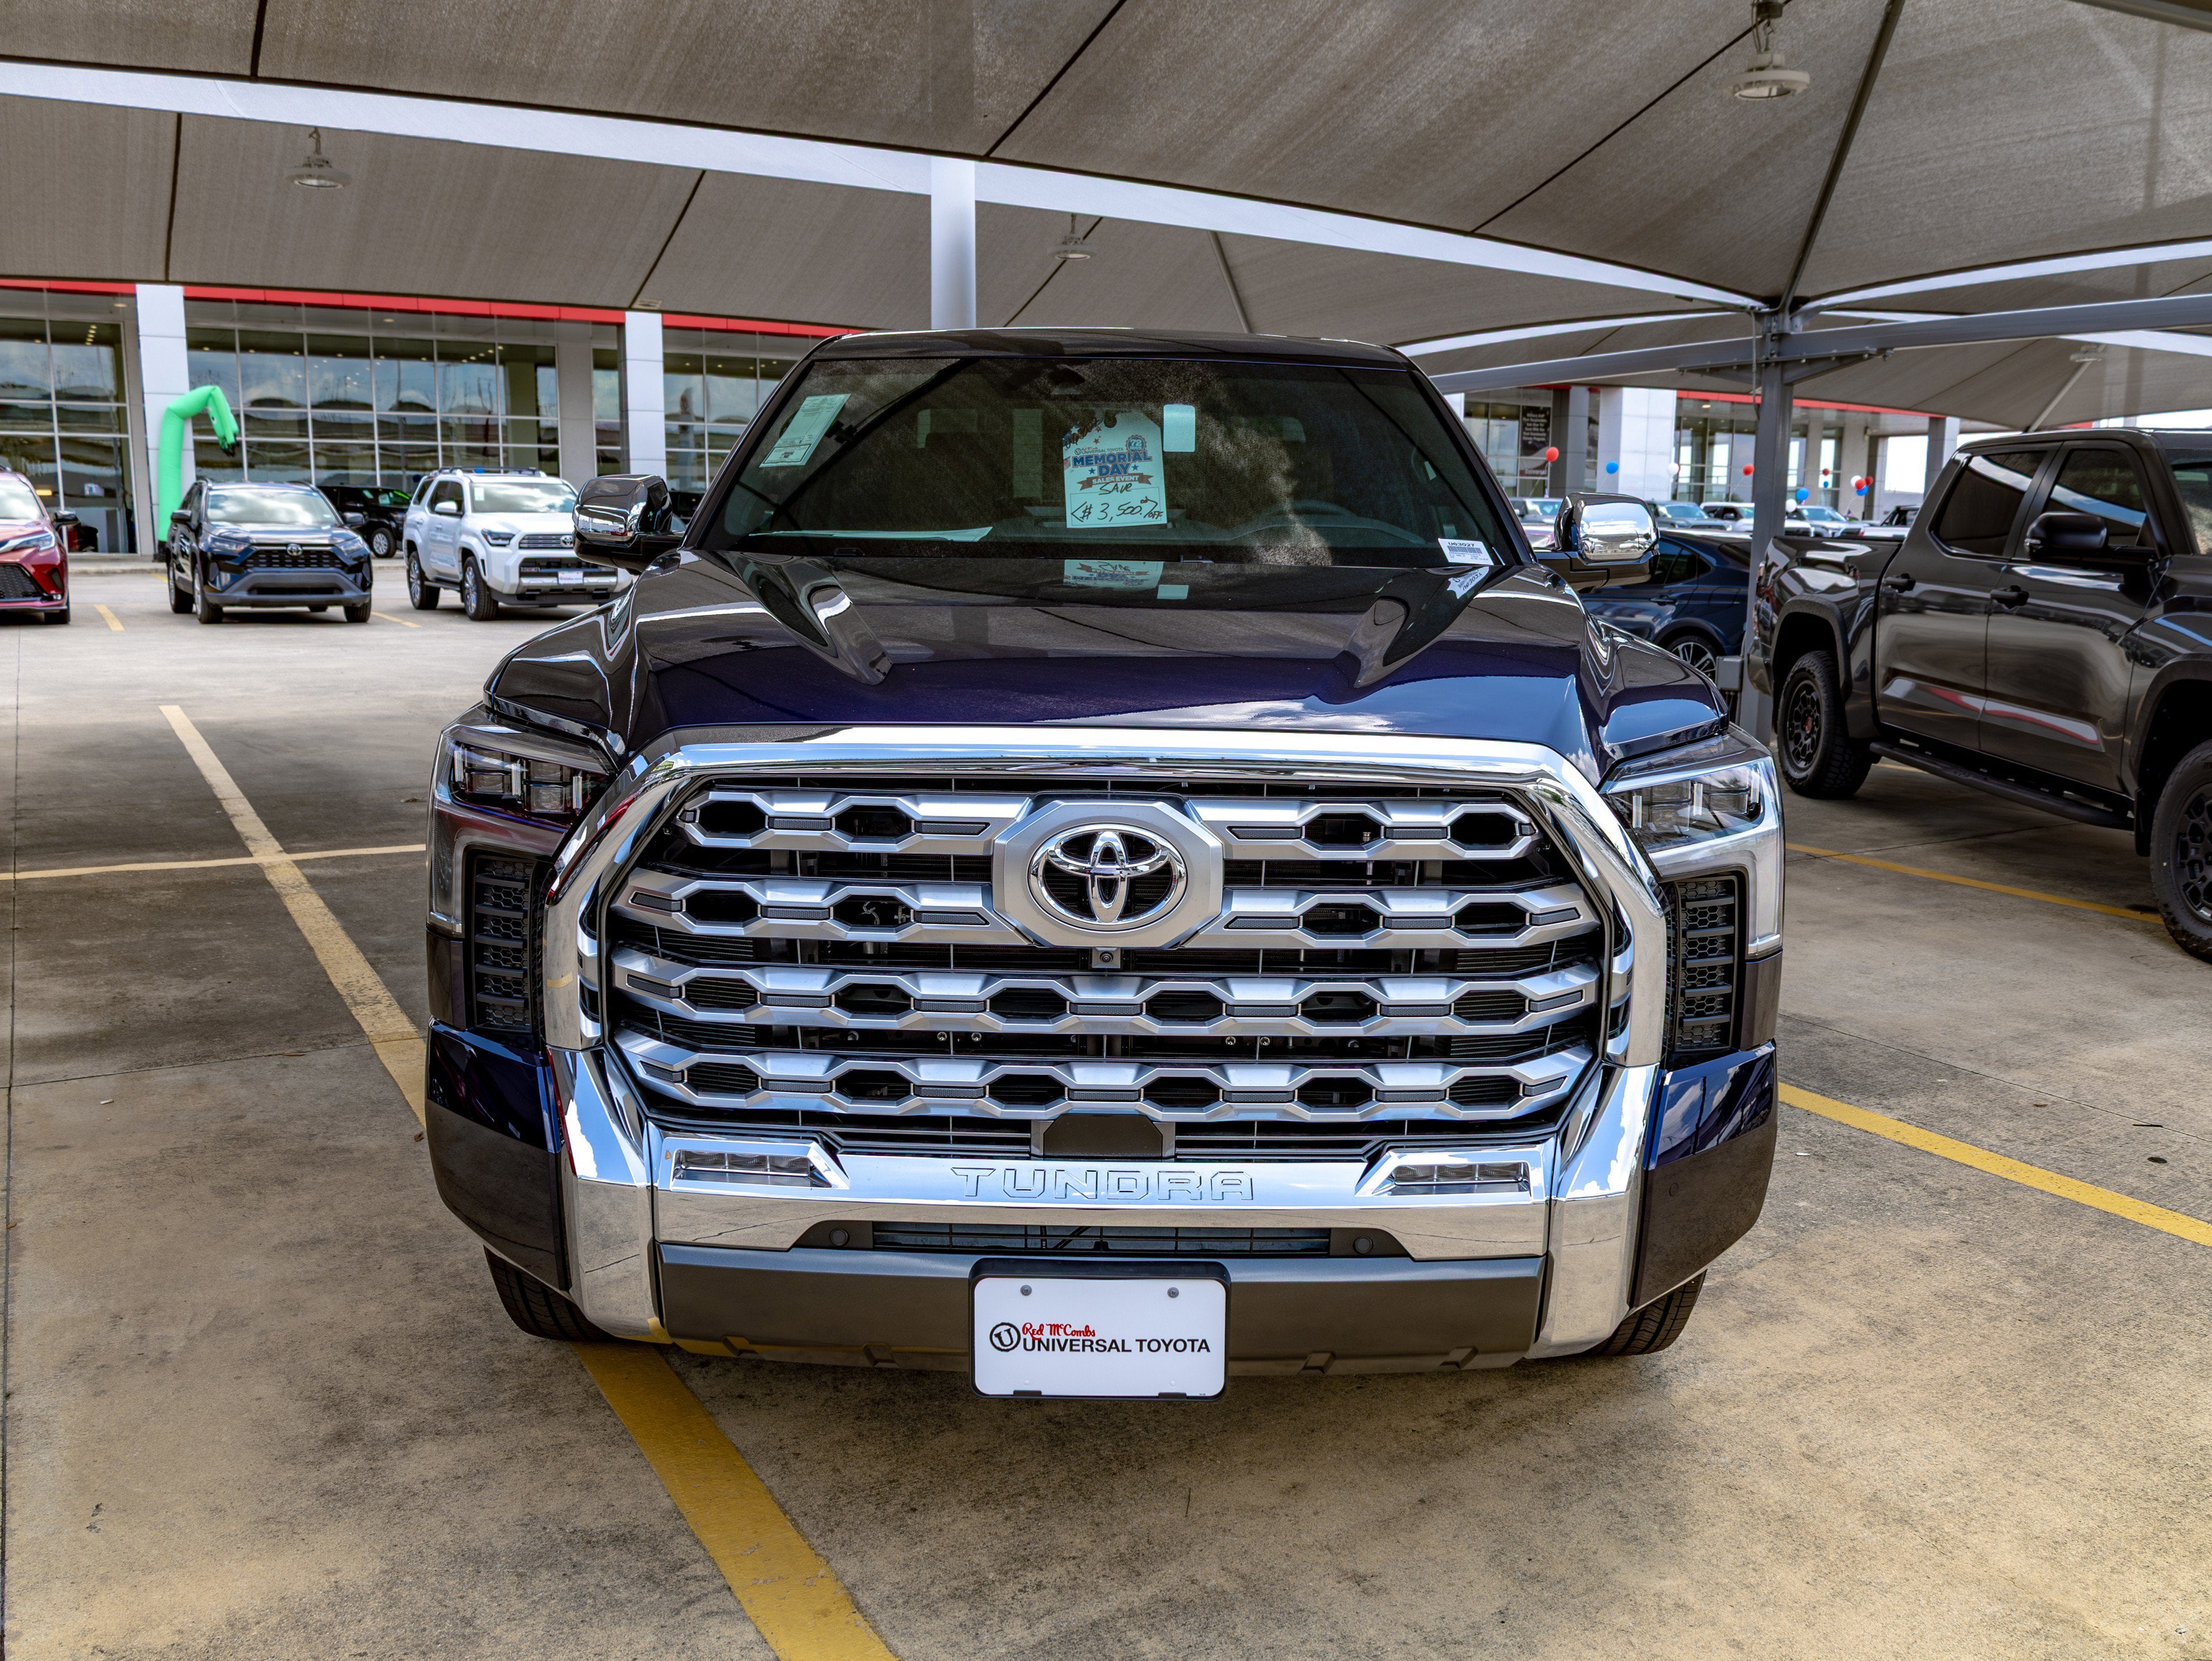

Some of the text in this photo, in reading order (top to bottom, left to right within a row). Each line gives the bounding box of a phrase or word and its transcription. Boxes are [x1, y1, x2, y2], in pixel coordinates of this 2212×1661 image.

[1072, 451, 1152, 468] MEMORIAL
[1098, 463, 1131, 477] DAY
[950, 1167, 1254, 1201] TUNDRA
[1022, 1322, 1096, 1341] Red McCombs
[1023, 1338, 1131, 1353] UNIVERSAL
[1135, 1338, 1211, 1353] TOYOTA
